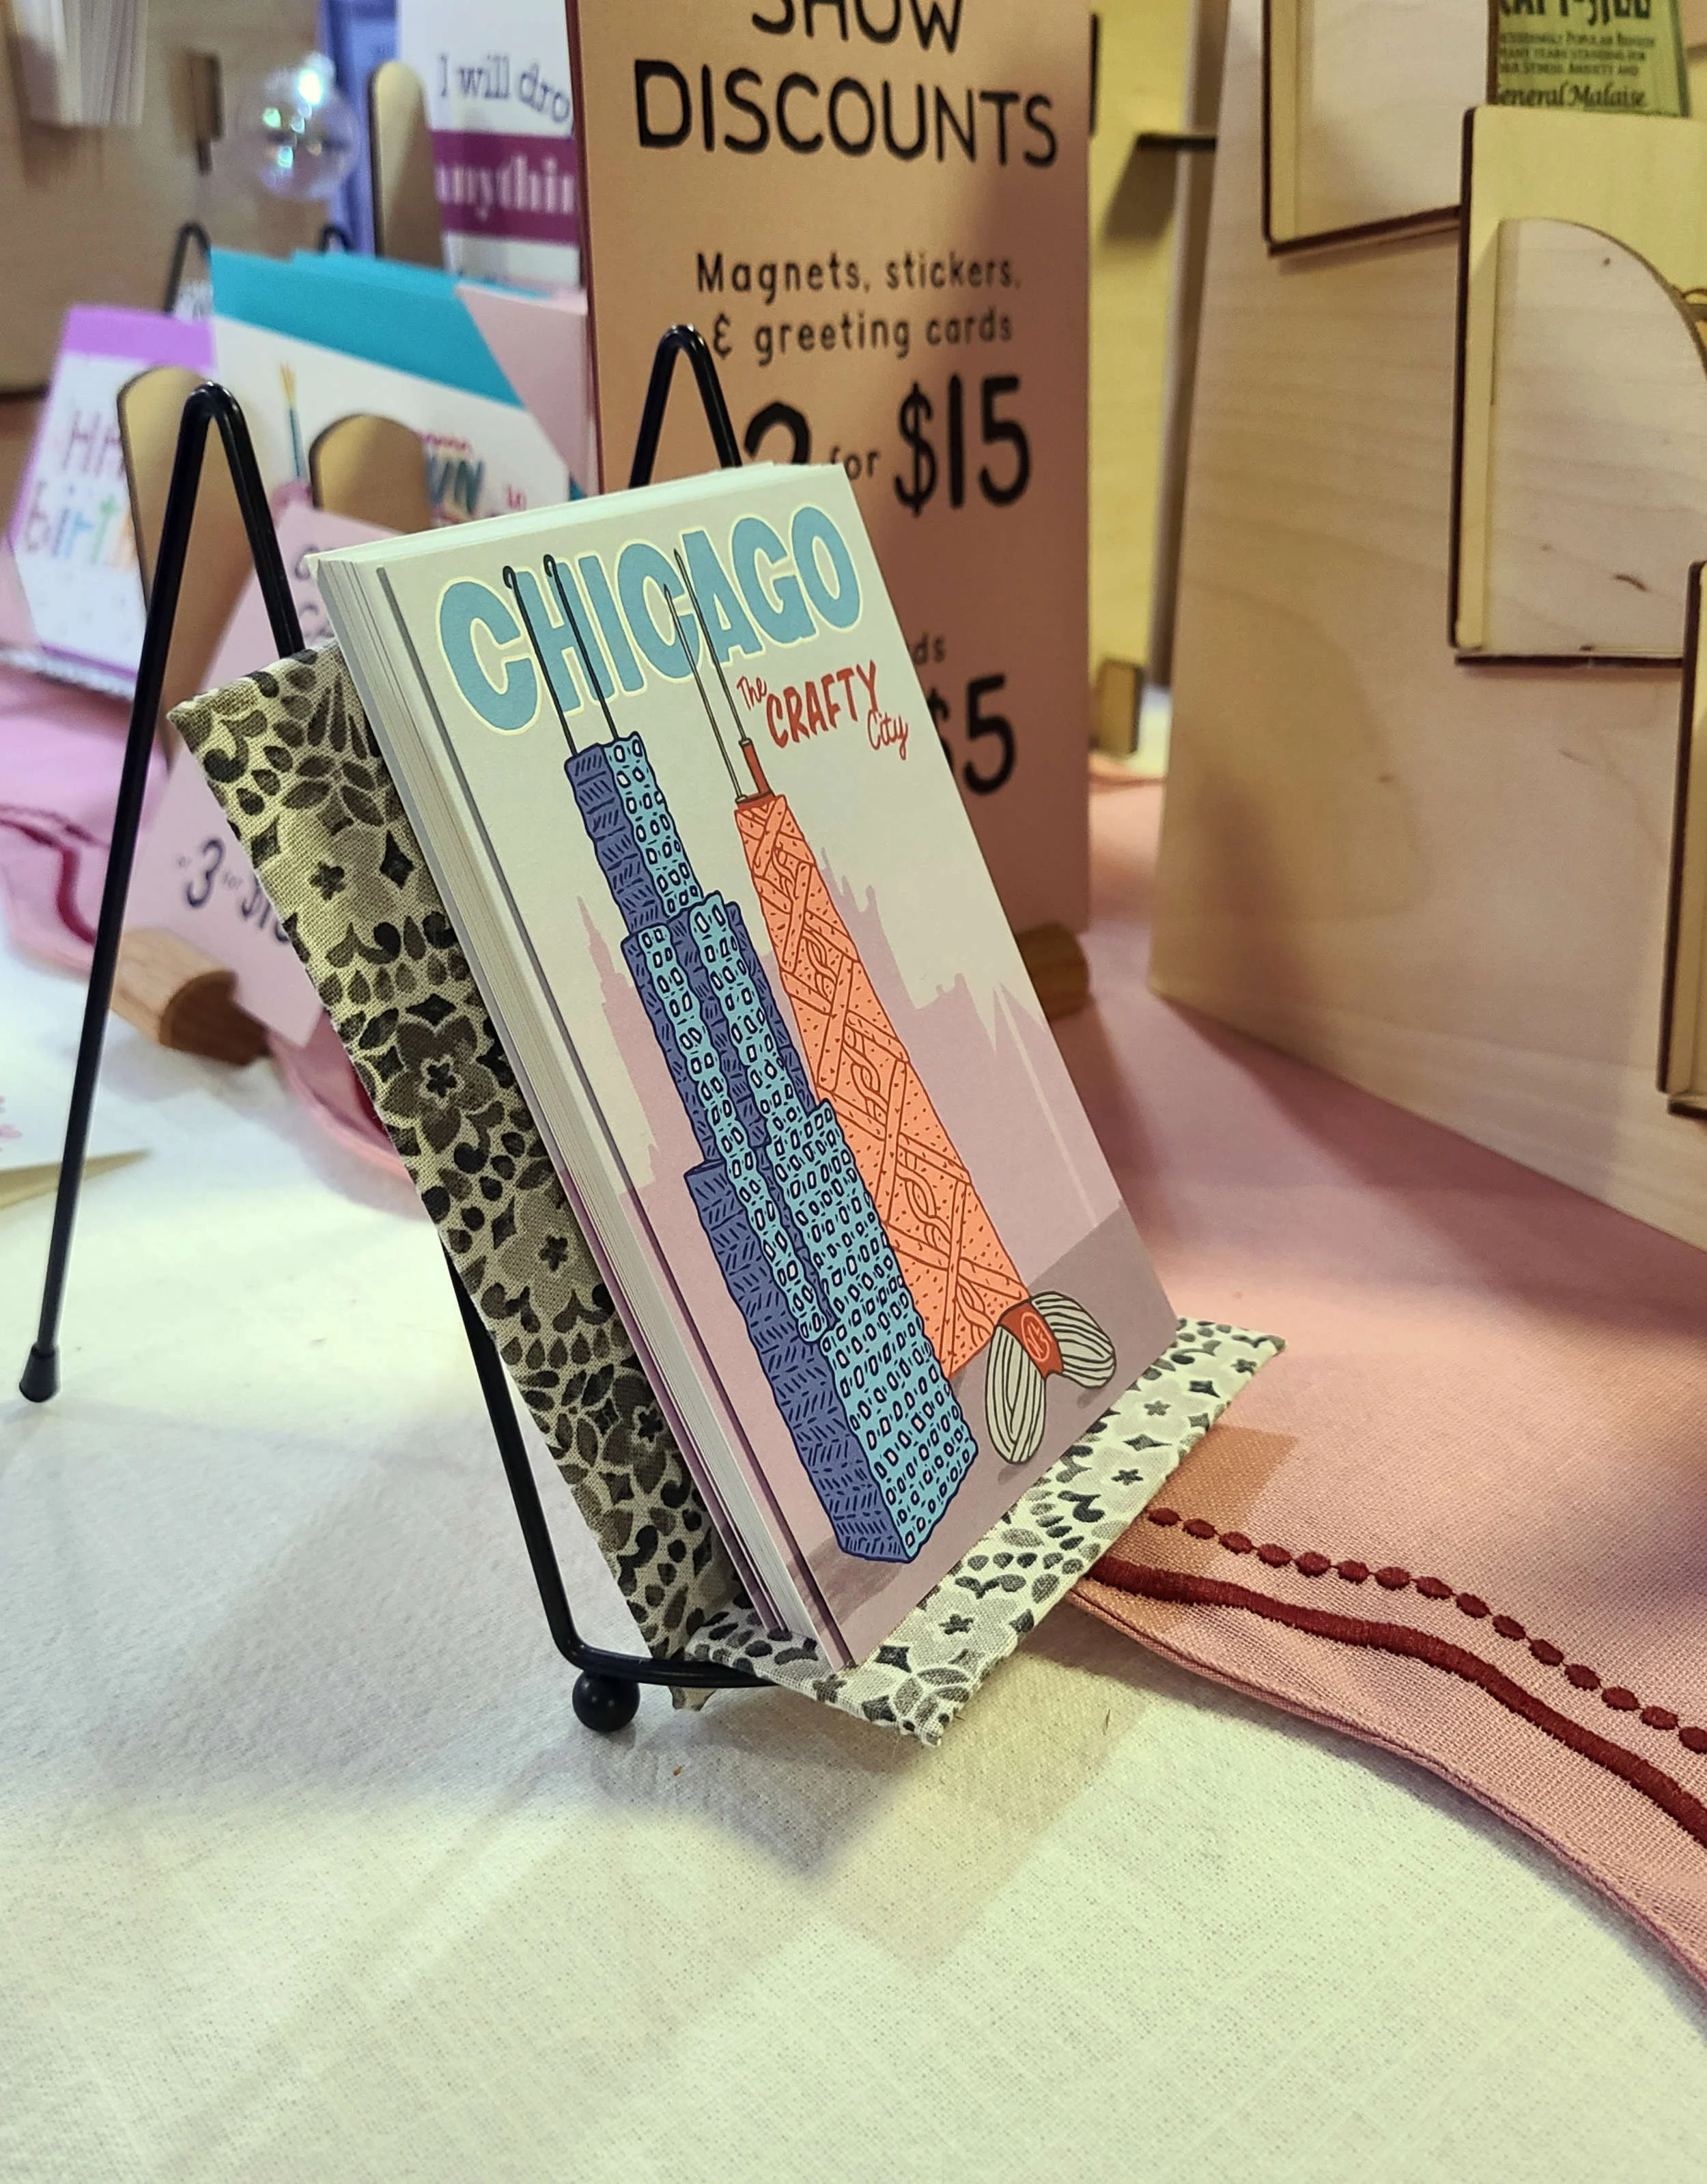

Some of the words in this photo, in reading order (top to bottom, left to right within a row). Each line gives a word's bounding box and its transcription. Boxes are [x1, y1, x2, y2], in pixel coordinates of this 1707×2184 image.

[459, 55, 510, 99] will
[518, 63, 574, 130] dro
[634, 58, 1058, 167] DISCOUNTS
[1499, 81, 1568, 105] eneral
[696, 251, 871, 305] Magnets,
[754, 311, 910, 367] greeting
[925, 308, 1013, 346] cards
[830, 445, 881, 479] for
[894, 374, 1031, 517] $15
[435, 503, 863, 736] CHICAGO
[737, 675, 767, 710] The
[766, 660, 879, 748] CRAFTY
[866, 709, 909, 761] City
